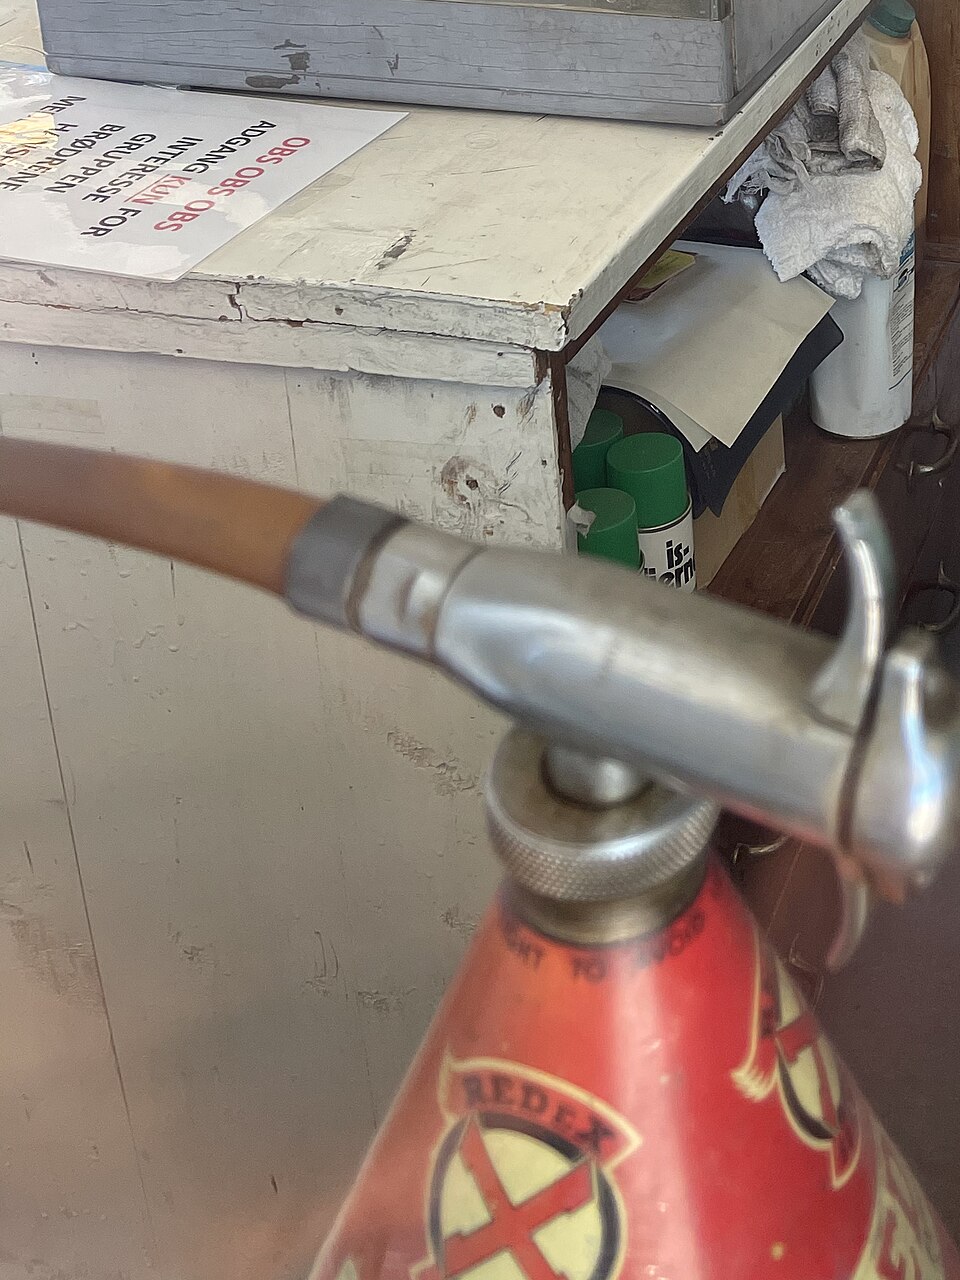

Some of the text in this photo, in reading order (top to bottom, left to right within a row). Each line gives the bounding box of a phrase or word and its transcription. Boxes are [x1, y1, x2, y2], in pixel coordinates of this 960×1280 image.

[0, 123, 126, 192] BRØDRENE
[43, 132, 158, 194] GRUPPEN
[80, 120, 277, 237] ADGANG KUN FOR
[81, 136, 204, 204] INTERESSE
[153, 137, 311, 232] OBS OBS OBS
[665, 540, 690, 570] is-
[461, 1069, 617, 1143] REDEX
